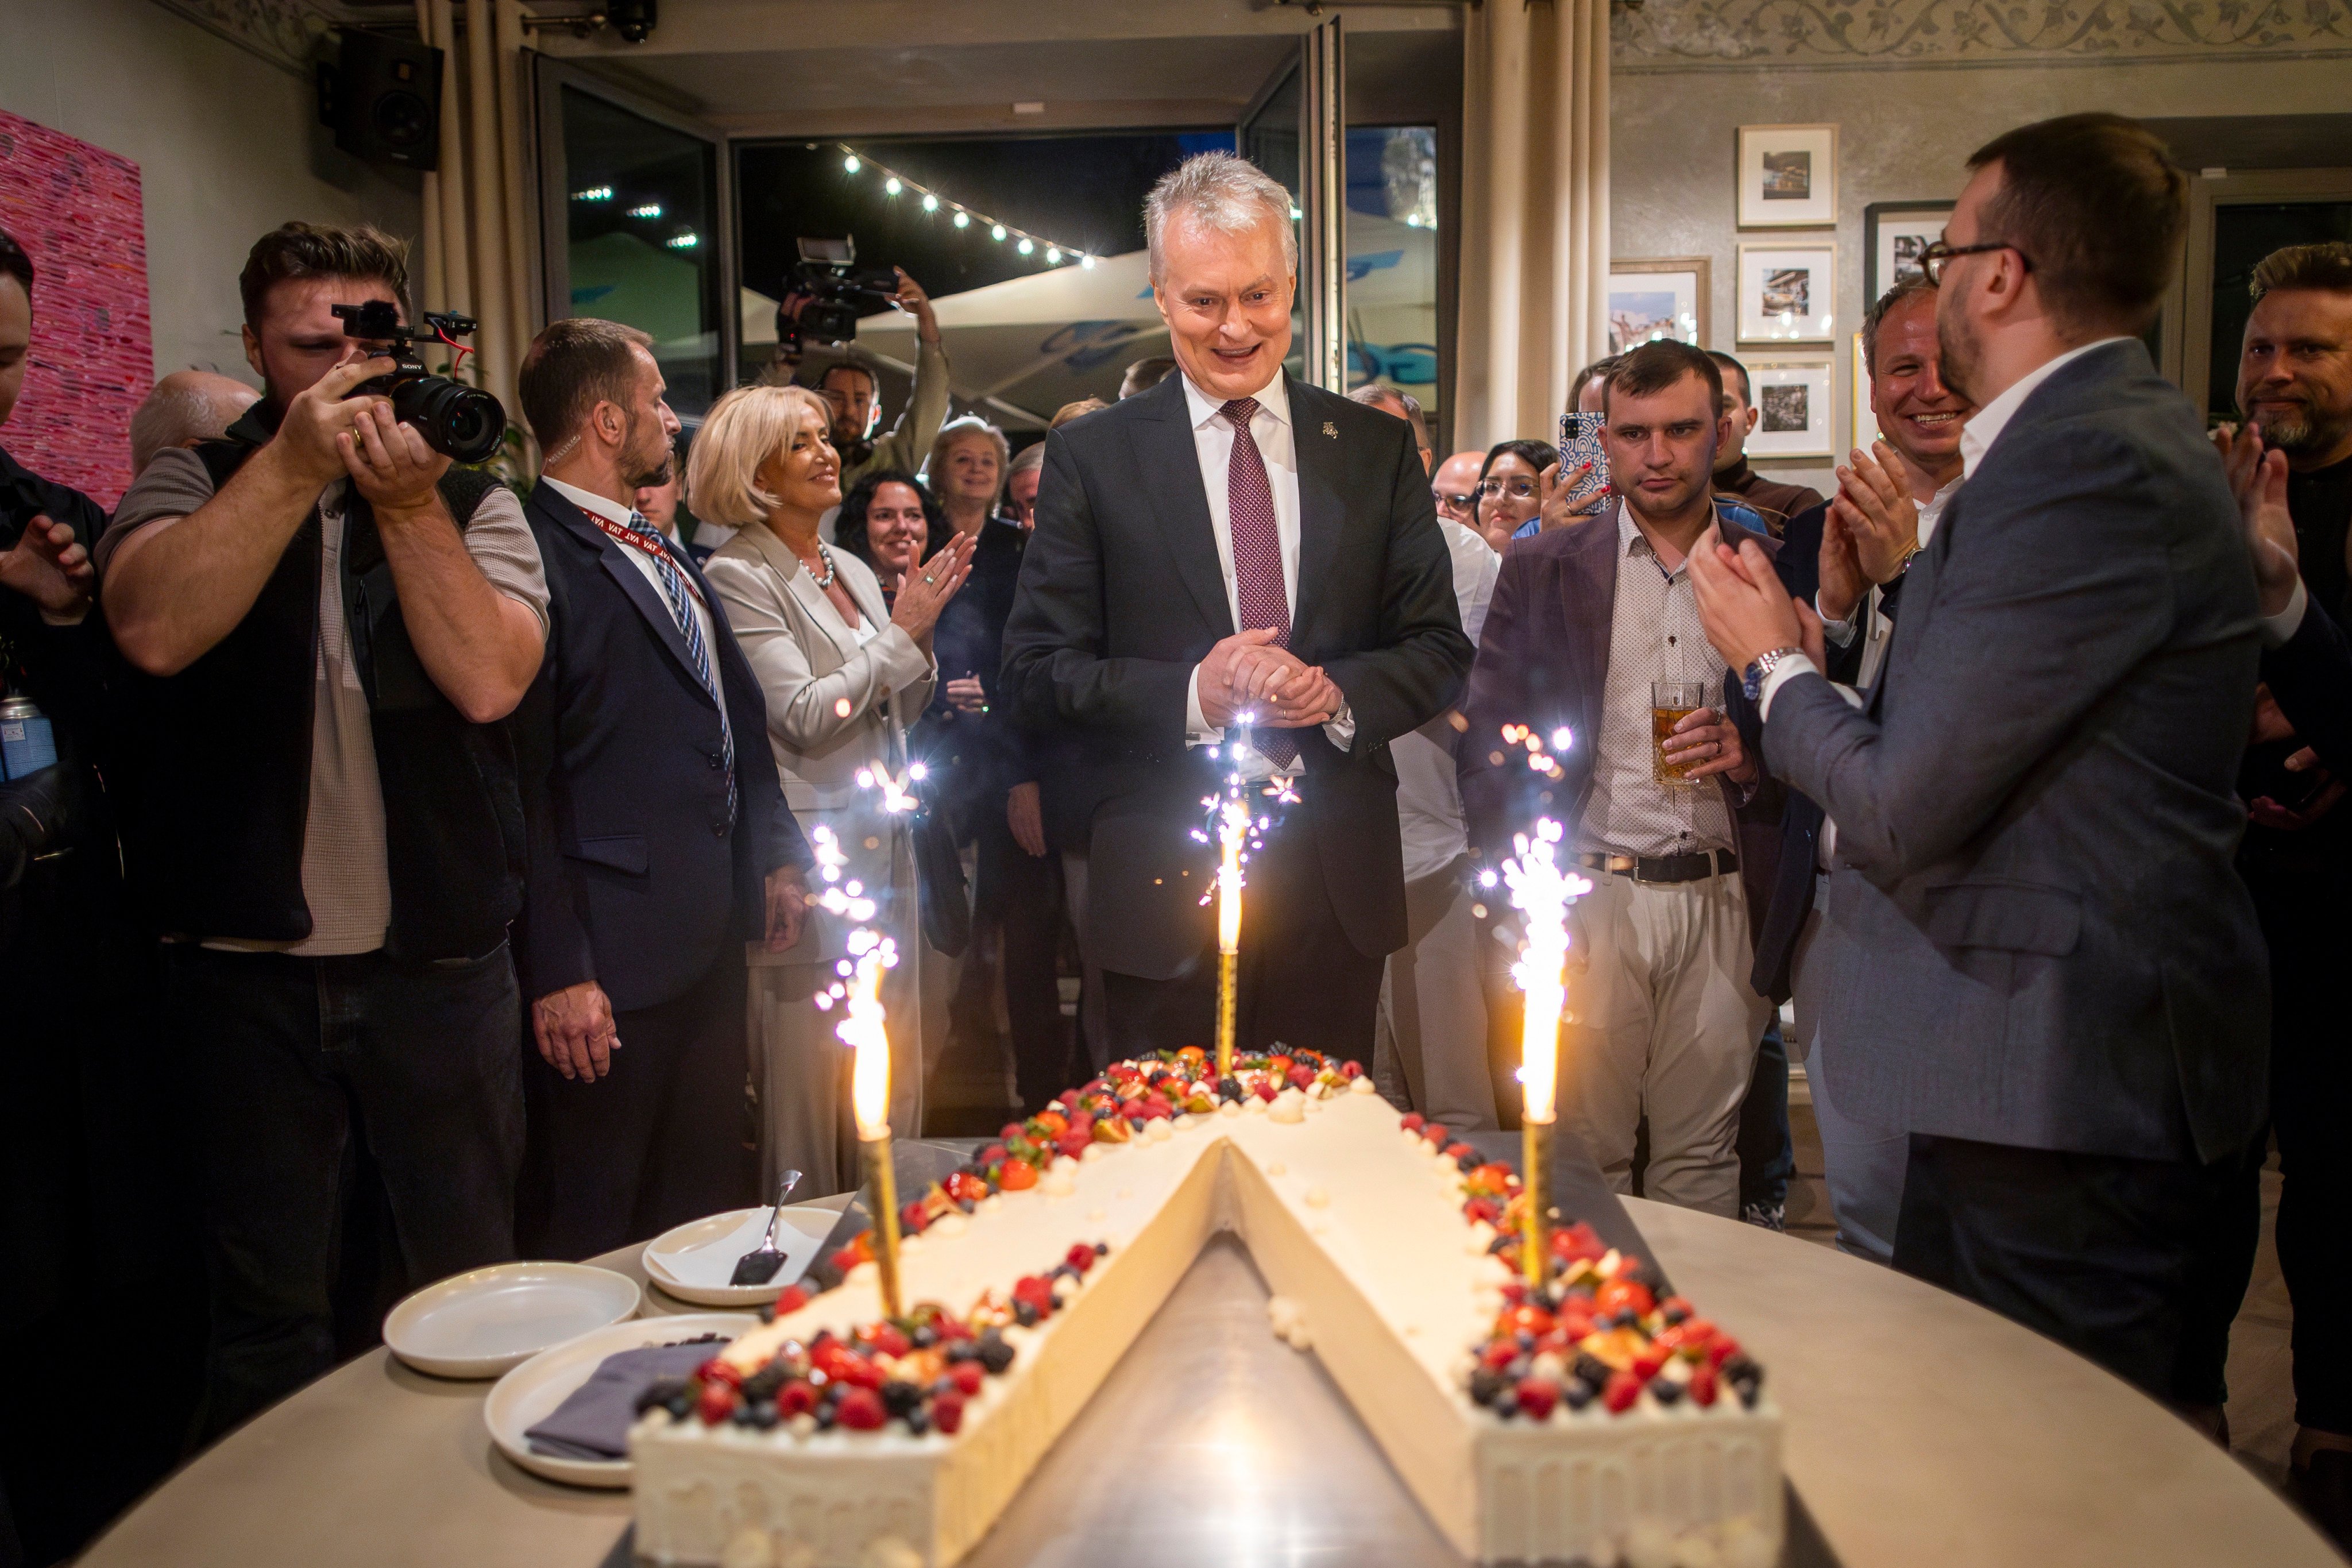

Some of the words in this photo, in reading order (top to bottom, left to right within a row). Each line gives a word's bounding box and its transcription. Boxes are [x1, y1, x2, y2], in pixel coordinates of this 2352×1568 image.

[608, 523, 623, 535] VAT
[625, 532, 639, 544] VAT
[643, 540, 658, 551] VAT
[659, 550, 670, 562] VAT
